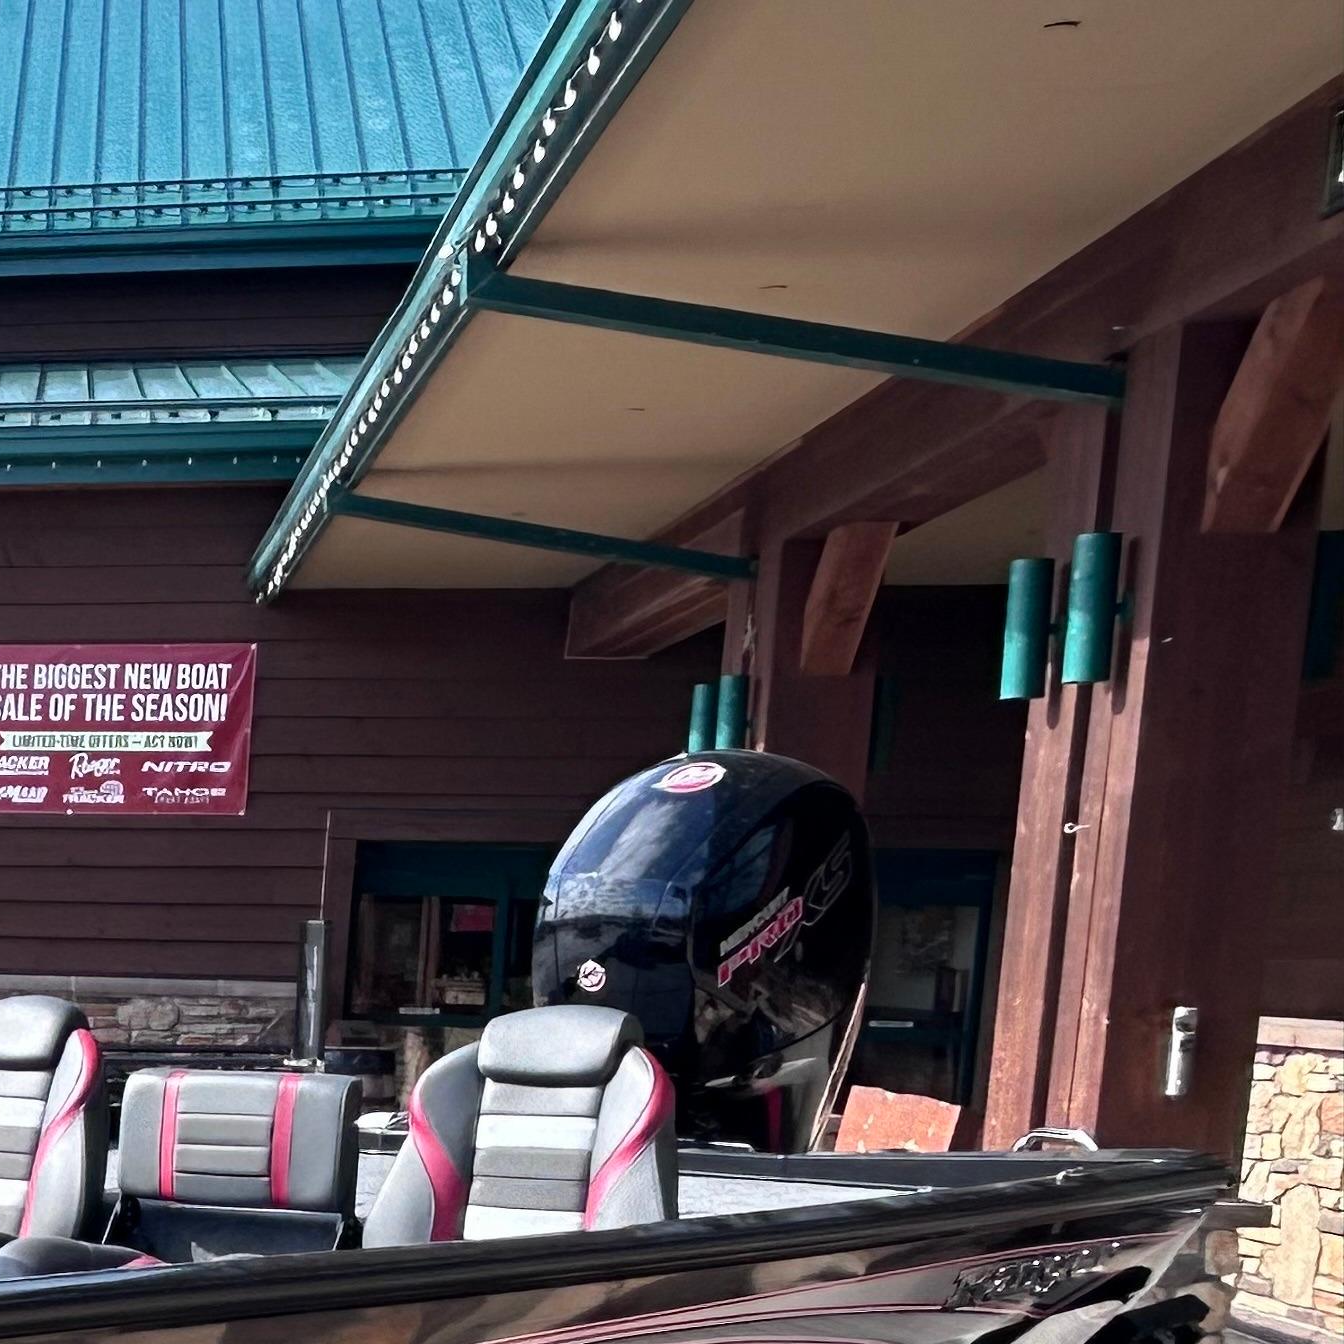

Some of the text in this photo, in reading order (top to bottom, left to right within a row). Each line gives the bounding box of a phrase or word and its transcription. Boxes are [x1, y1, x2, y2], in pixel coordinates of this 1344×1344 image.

[33, 663, 120, 690] BIGGEST
[124, 663, 173, 689] NEW
[176, 663, 232, 689] BOAT
[48, 693, 78, 721] OF
[82, 693, 126, 721] THE
[131, 693, 228, 722] SEASON!
[140, 760, 231, 773] NITRO
[141, 787, 226, 798] TAHOE
